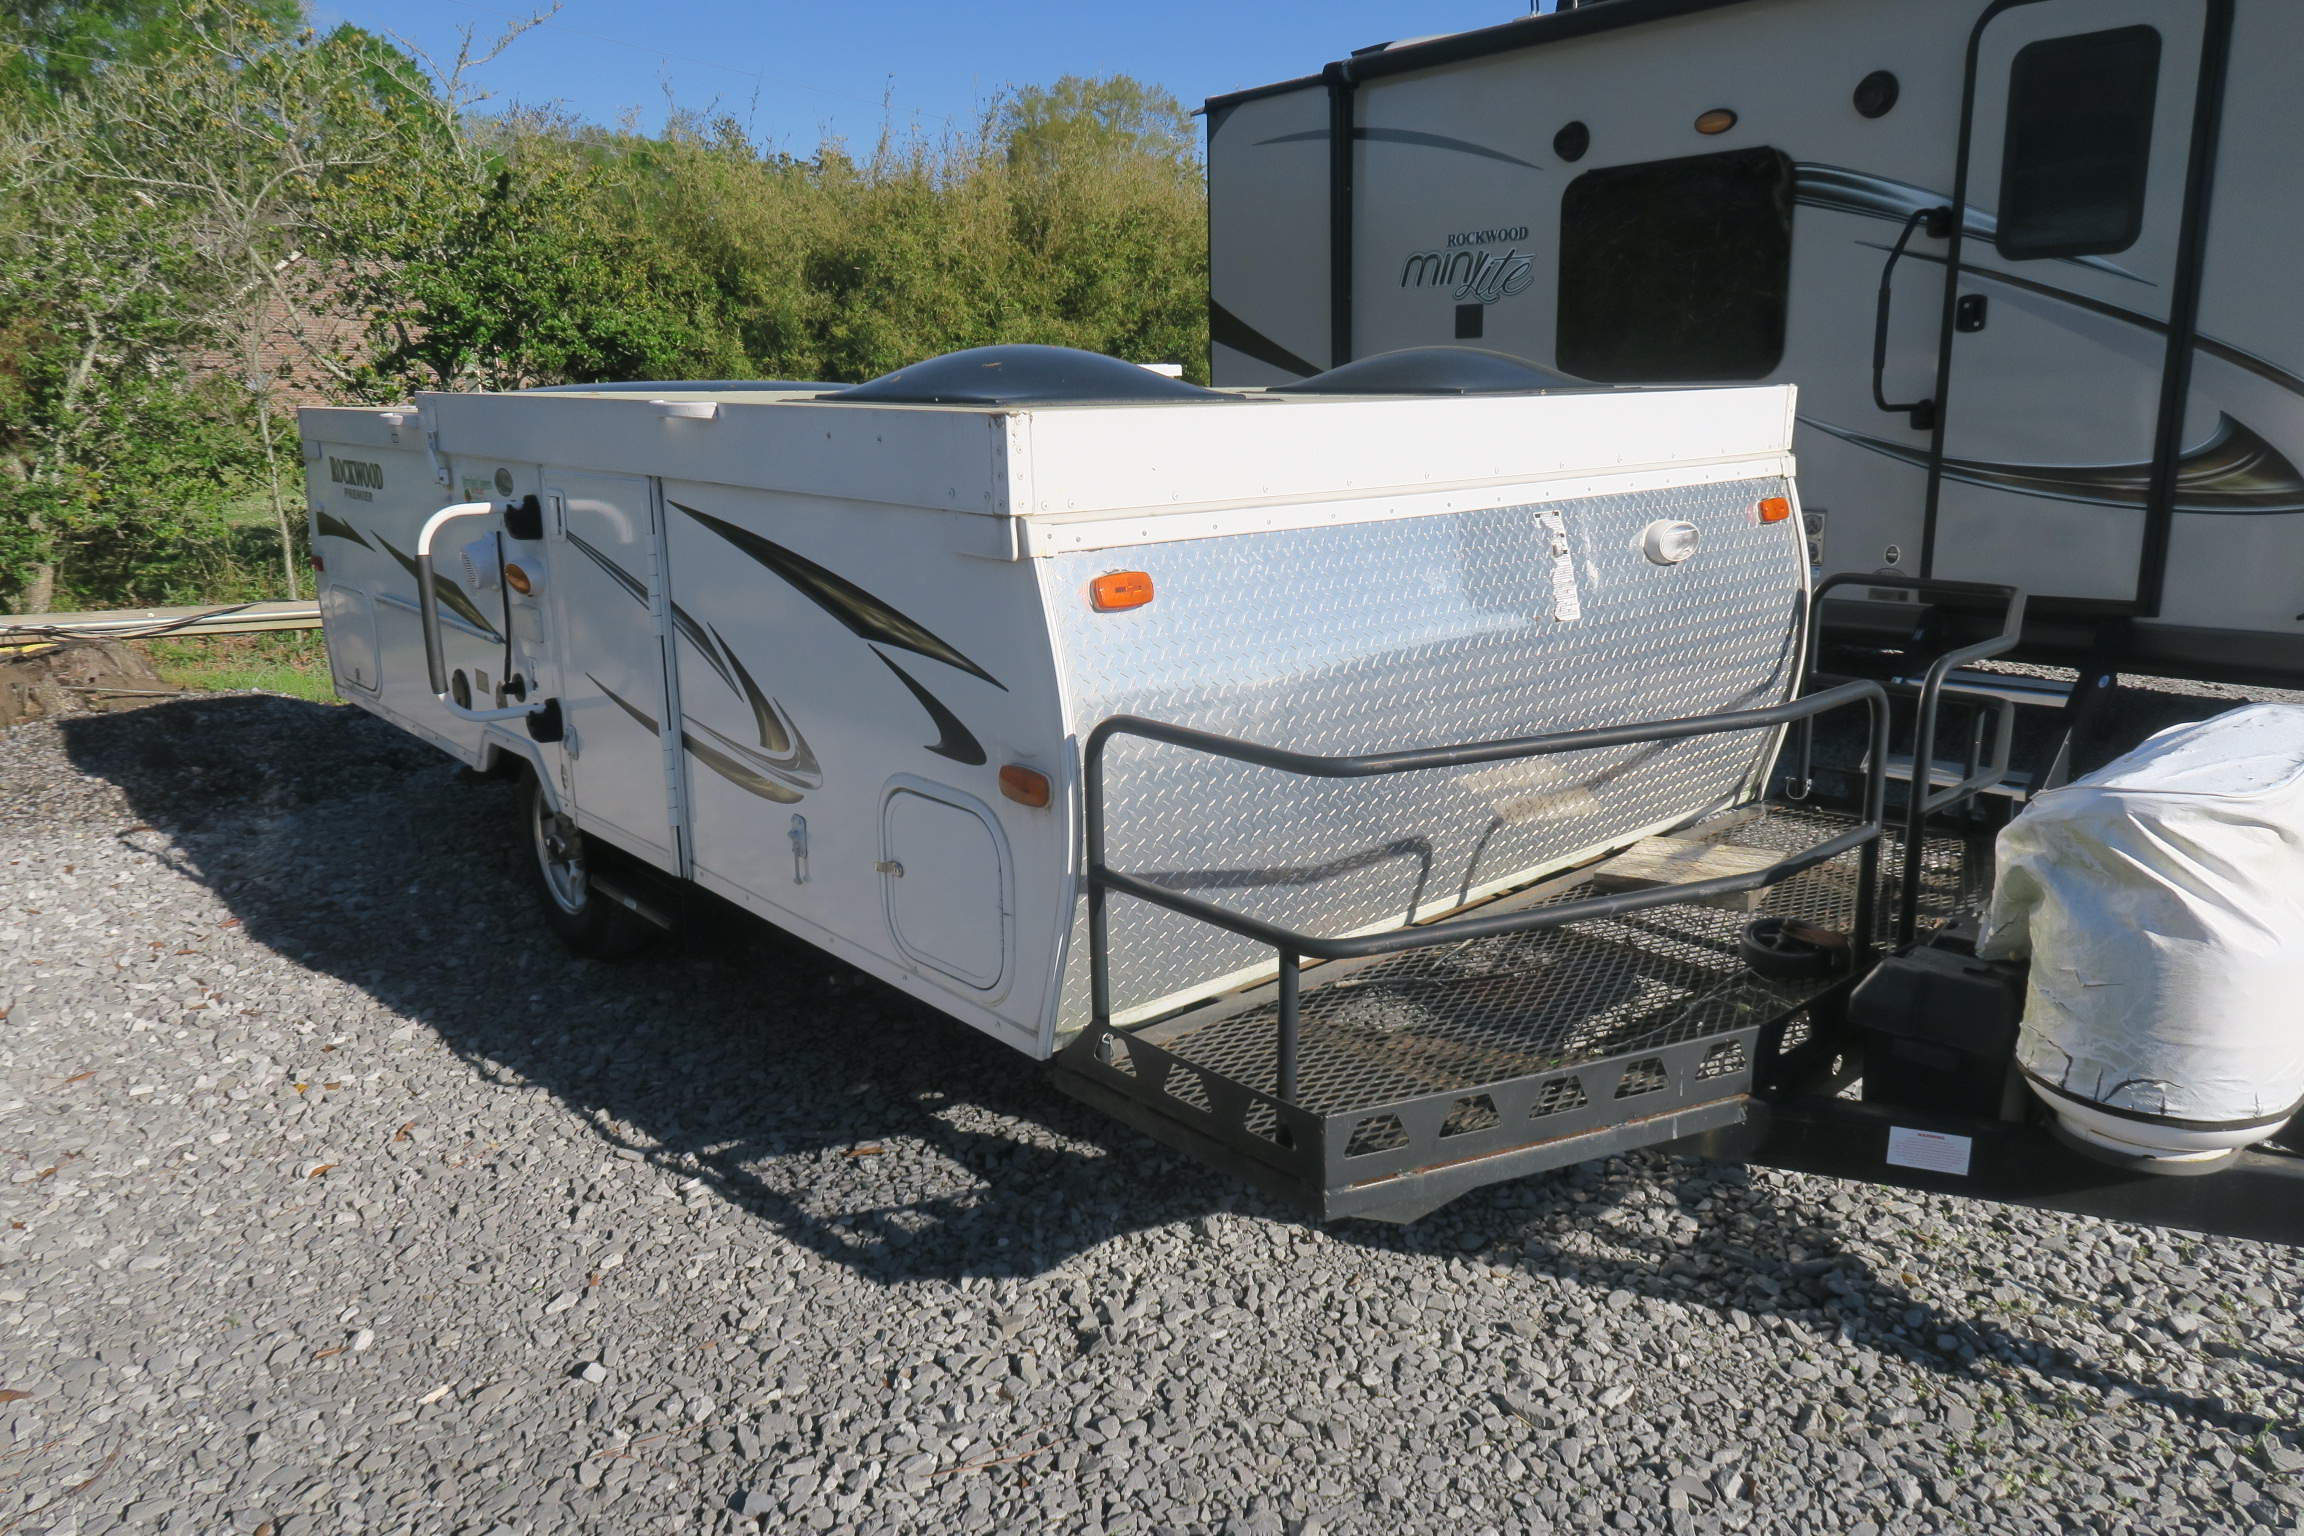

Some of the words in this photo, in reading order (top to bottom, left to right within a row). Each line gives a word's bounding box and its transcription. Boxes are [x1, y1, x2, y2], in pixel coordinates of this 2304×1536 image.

[1447, 226, 1528, 247] ROCKWOOD
[328, 455, 384, 490] ROCKWOOD
[344, 487, 373, 502] PREMIER
